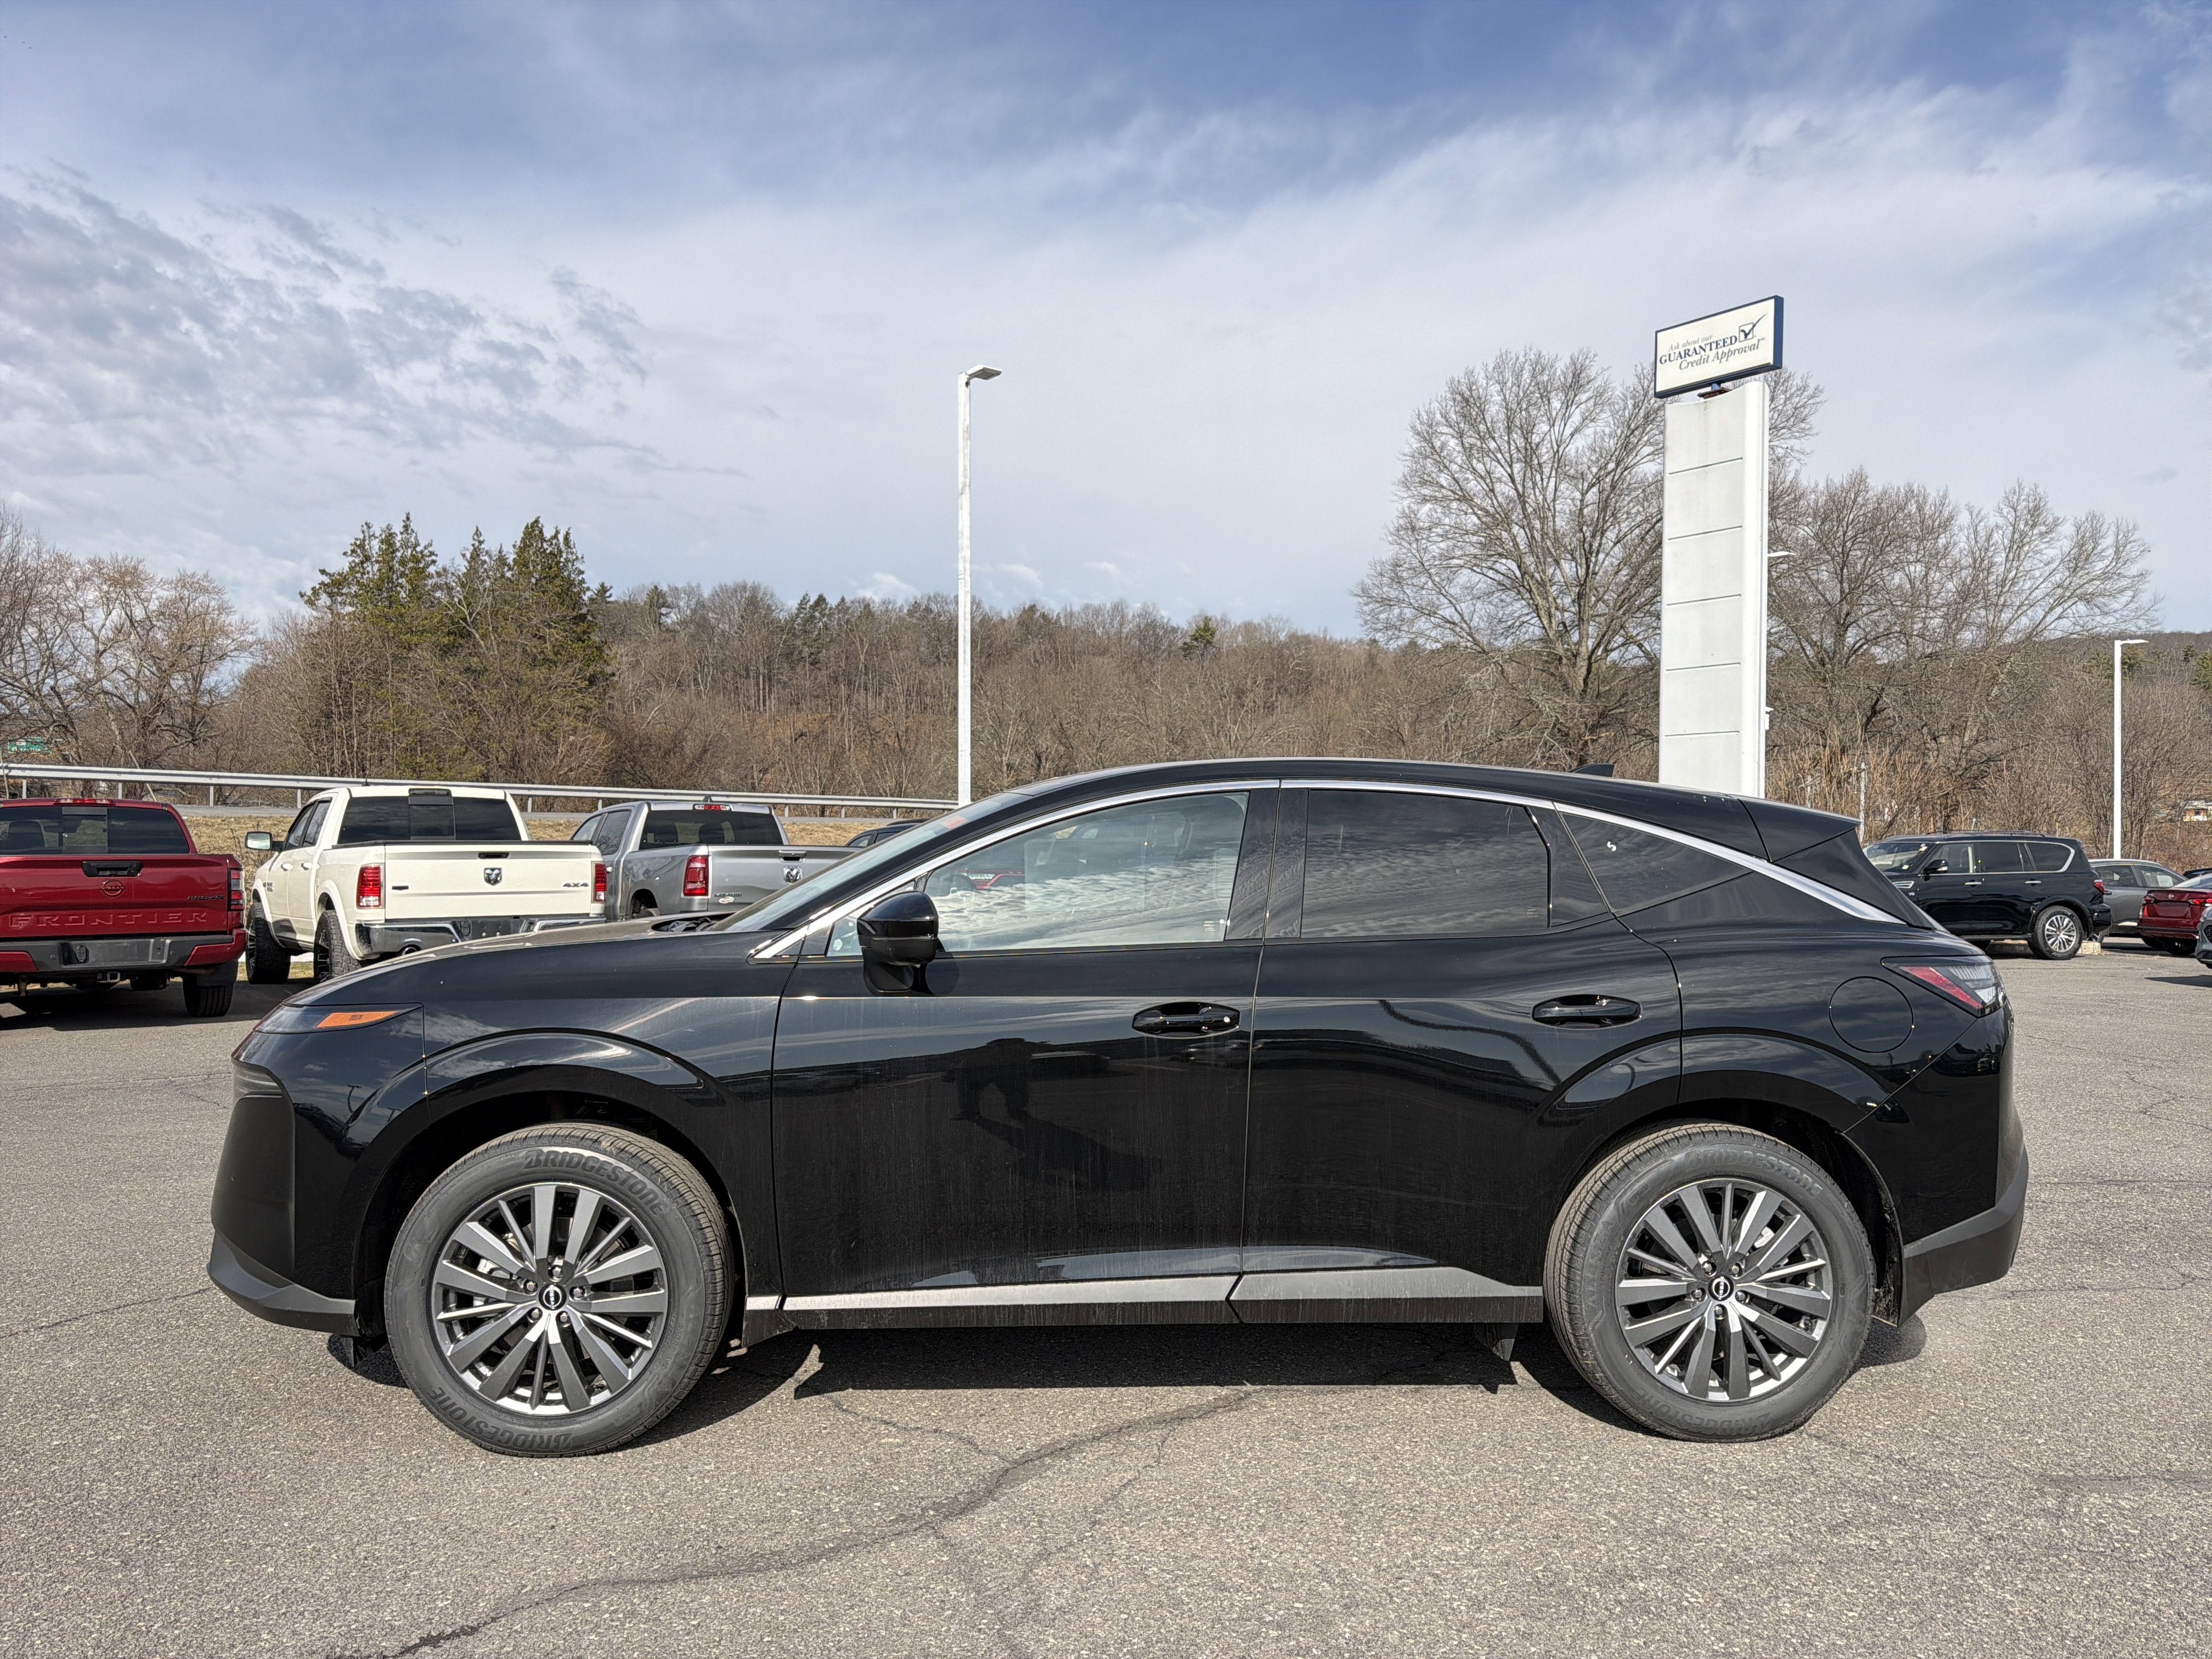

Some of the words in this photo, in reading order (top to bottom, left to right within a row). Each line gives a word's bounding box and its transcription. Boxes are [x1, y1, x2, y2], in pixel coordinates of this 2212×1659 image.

[1659, 335, 1737, 365] GUARANTEED
[1668, 342, 1680, 352] Ask
[1681, 337, 1700, 348] about
[1701, 335, 1713, 343] our
[1679, 354, 1709, 370] Credit
[1712, 338, 1760, 364] Approval
[8, 912, 207, 928] FRONTIER
[523, 1148, 663, 1215] BRIDGESTONE
[1685, 1148, 1824, 1198] BRIDGESTONE
[427, 1386, 572, 1450] BRIDGESTONE
